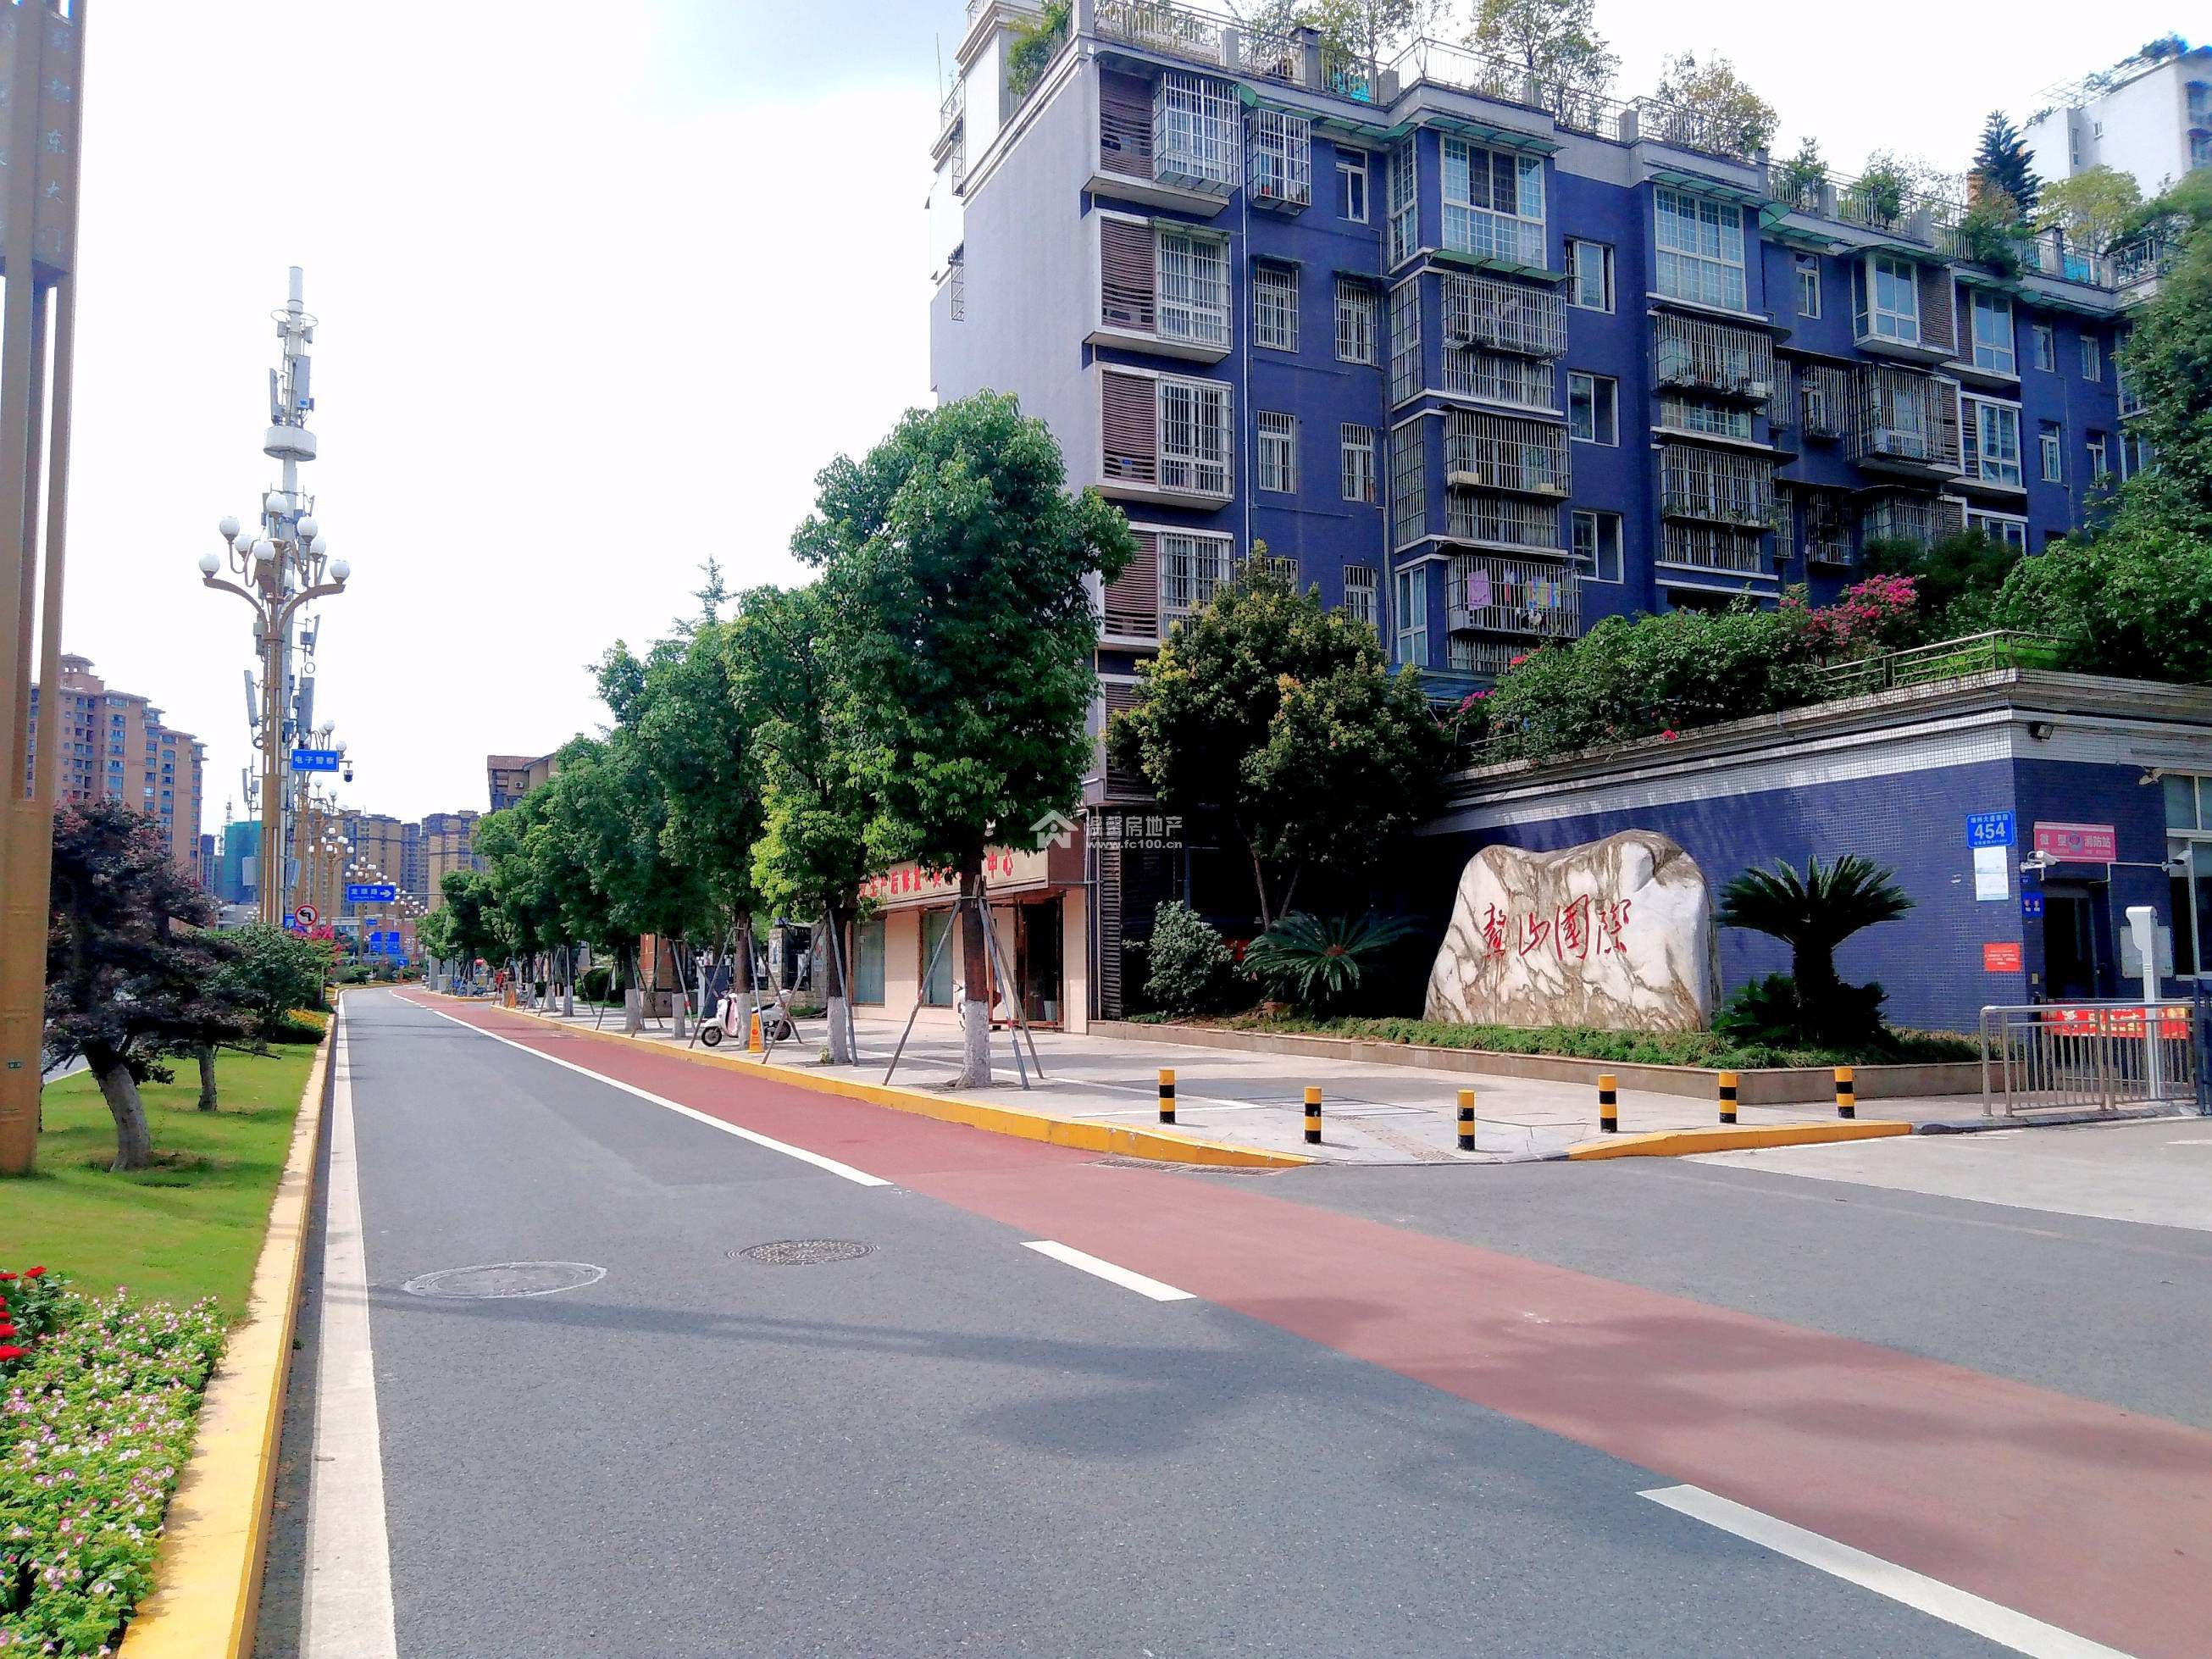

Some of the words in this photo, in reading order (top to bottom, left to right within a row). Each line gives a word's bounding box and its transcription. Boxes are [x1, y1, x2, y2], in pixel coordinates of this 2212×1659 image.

[294, 755, 335, 765] 电子警察
[1974, 821, 2006, 840] 454
[2084, 835, 2112, 848] 消防站
